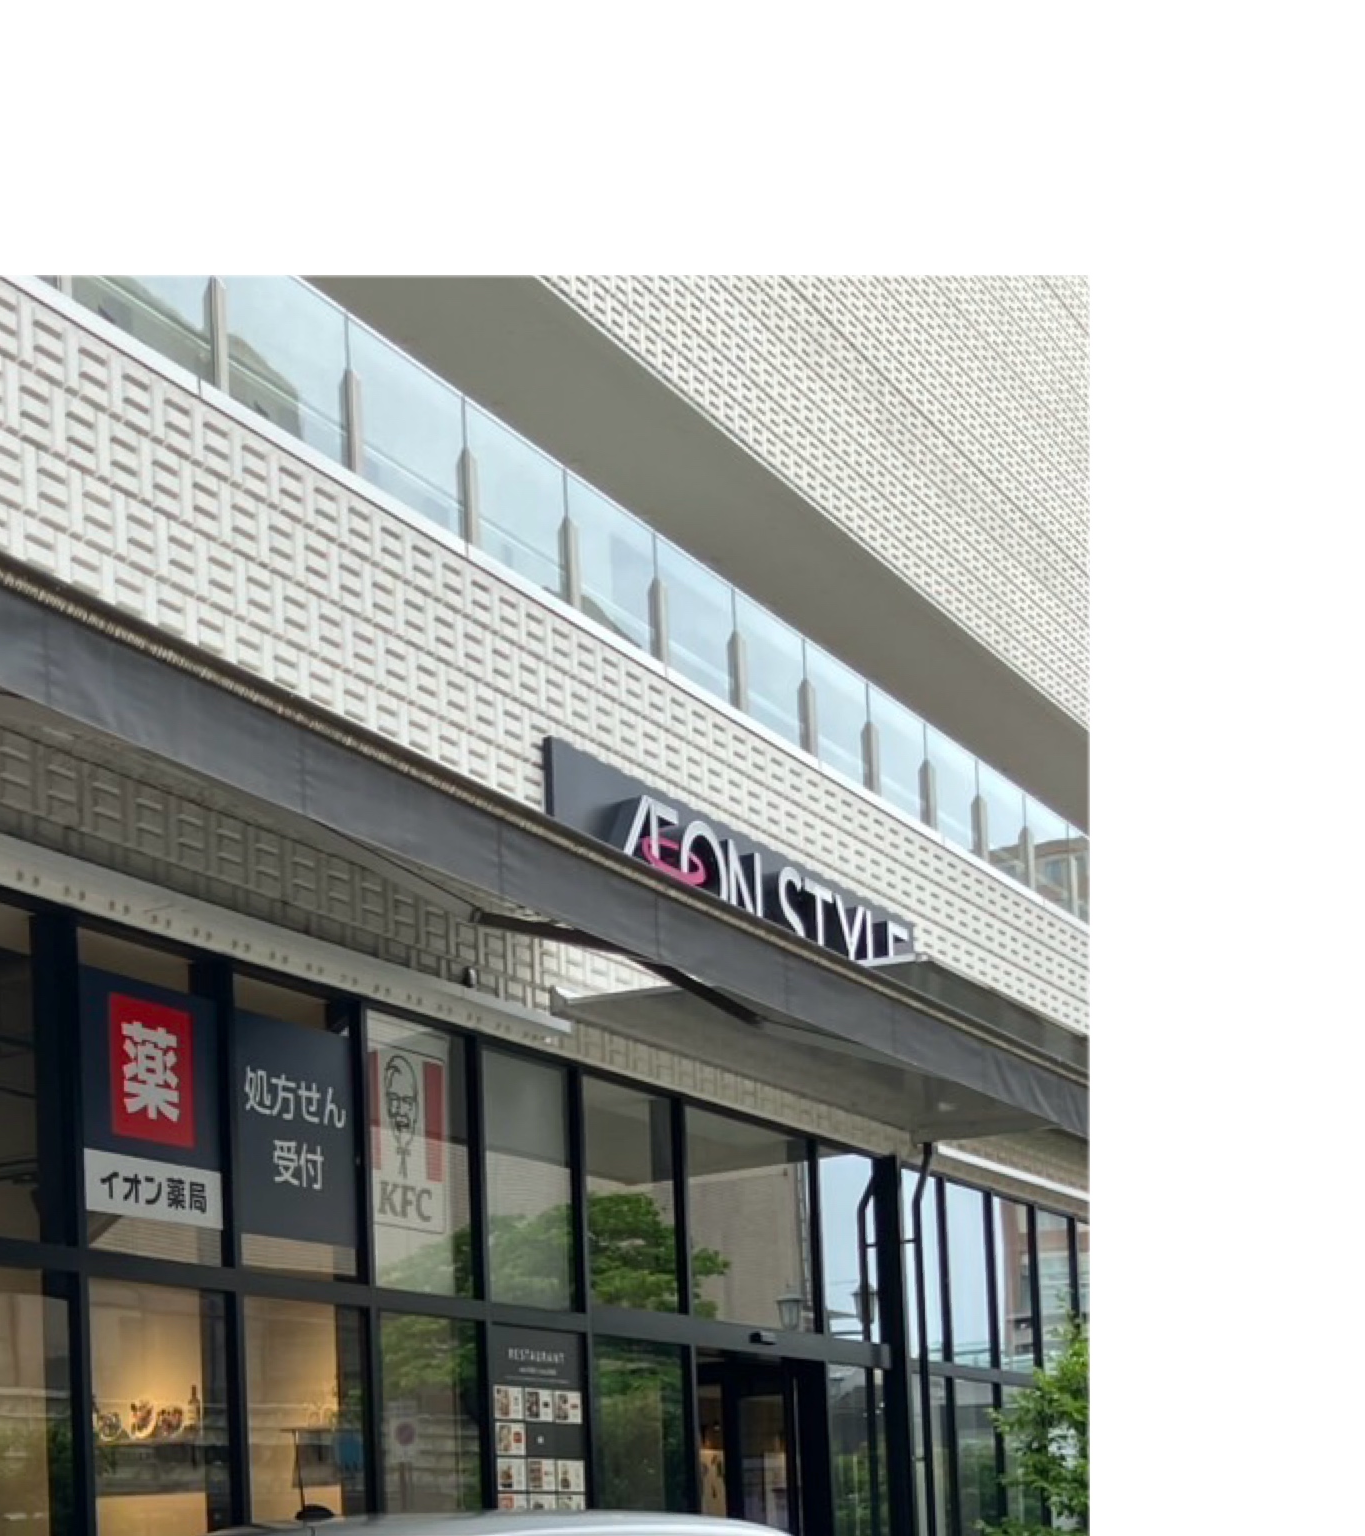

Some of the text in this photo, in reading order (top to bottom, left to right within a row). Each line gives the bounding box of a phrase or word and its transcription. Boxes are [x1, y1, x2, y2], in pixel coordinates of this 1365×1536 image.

[120, 1022, 180, 1122] 薬
[244, 1065, 347, 1129] 処方せん
[272, 1139, 324, 1190] 受付
[100, 1171, 207, 1214] イオン薬局
[378, 1180, 433, 1223] KFC
